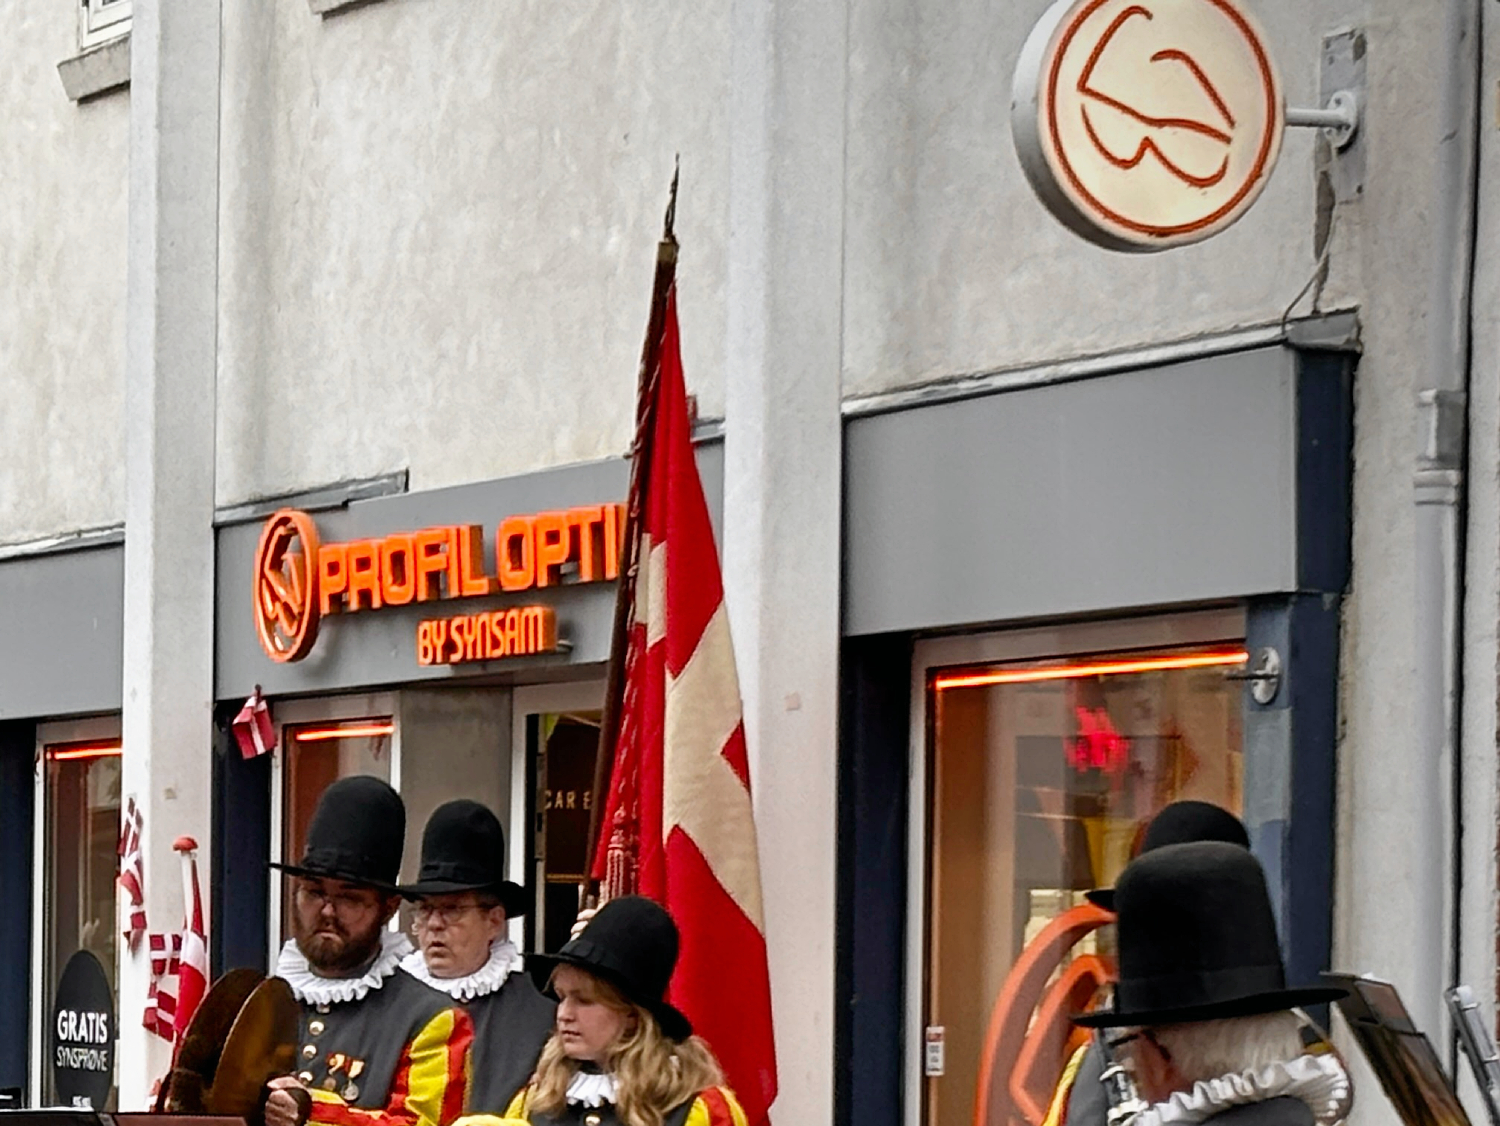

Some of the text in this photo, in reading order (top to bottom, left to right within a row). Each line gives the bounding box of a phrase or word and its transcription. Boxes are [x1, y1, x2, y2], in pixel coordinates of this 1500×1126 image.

[319, 504, 624, 614] PROFIL OPTI
[418, 606, 554, 665] BY SYNSAM
[57, 1010, 108, 1044] GRATIS
[56, 1045, 109, 1072] SYNSPRØVE
